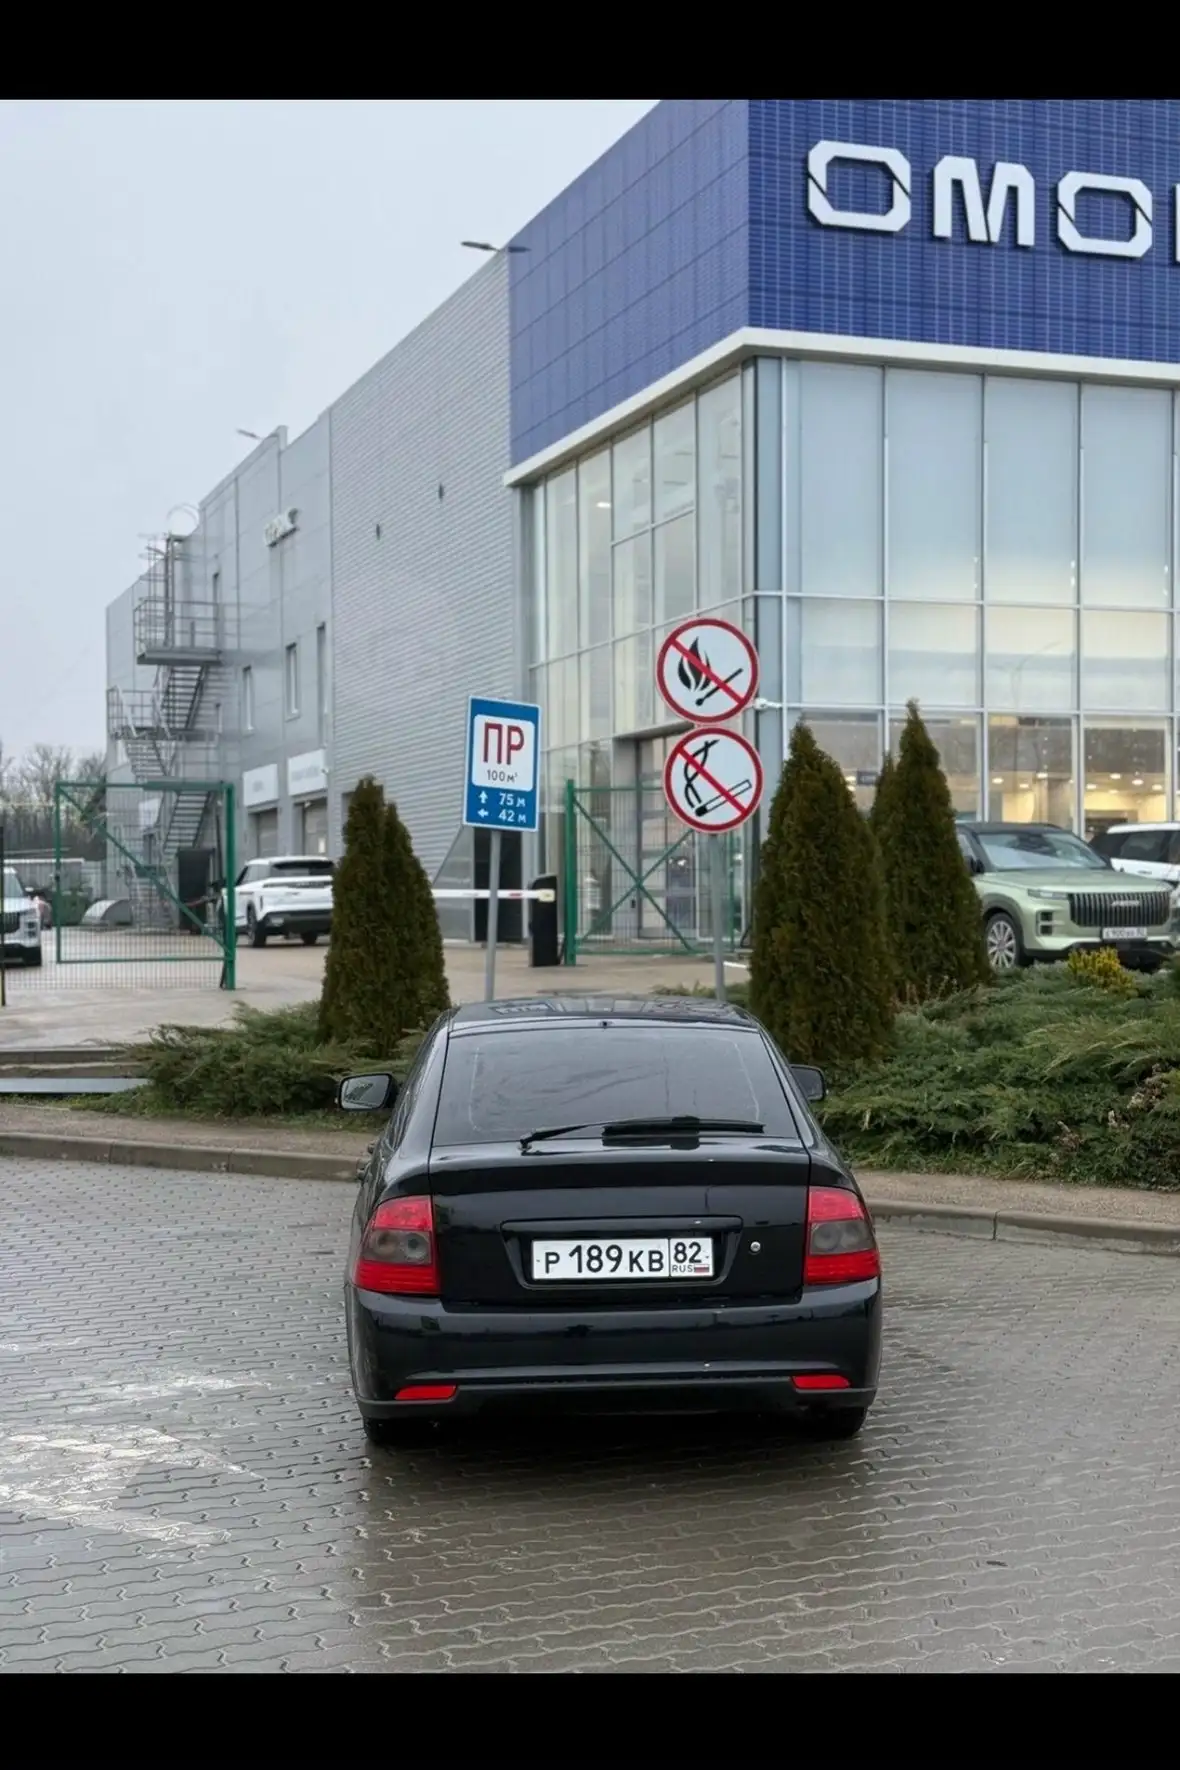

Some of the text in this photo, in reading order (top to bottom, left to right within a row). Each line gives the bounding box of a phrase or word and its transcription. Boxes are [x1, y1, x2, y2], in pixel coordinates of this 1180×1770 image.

[807, 139, 1180, 263] OMO
[482, 722, 525, 765] ПР
[499, 792, 514, 806] 75
[498, 808, 515, 822] 42
[673, 1241, 702, 1264] 82
[672, 1264, 693, 1273] RUS
